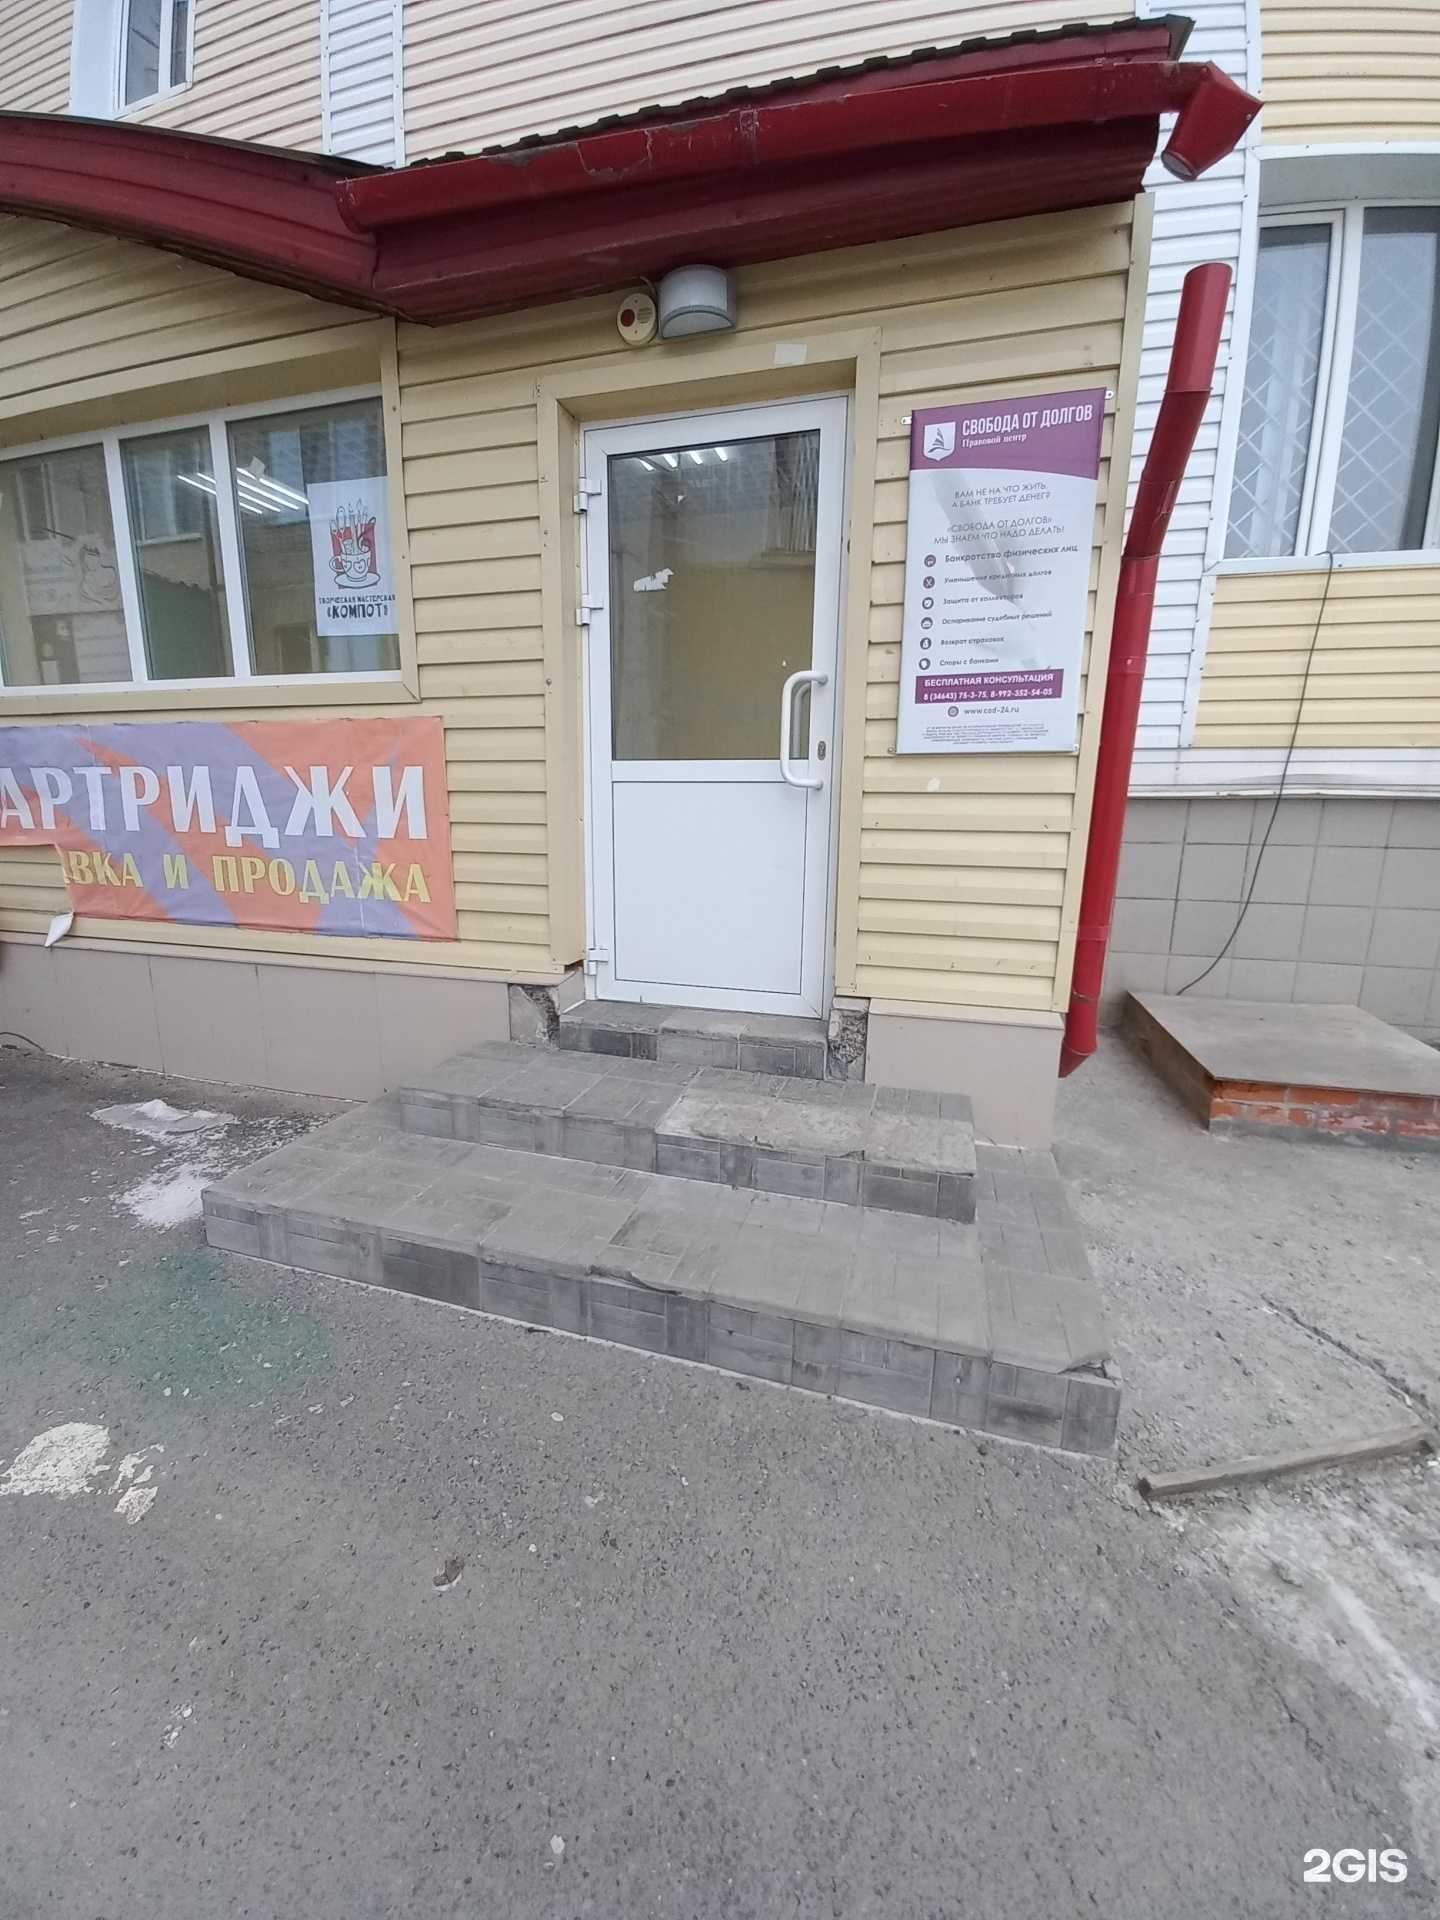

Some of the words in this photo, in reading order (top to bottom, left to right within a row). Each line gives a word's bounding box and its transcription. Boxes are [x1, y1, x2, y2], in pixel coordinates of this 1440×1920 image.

[962, 414, 1020, 436] СВОБОДА
[1022, 411, 1039, 429] ОТ
[1040, 404, 1093, 428] ДОЛГОВ
[962, 435, 1001, 448] Правовой
[1003, 433, 1027, 444] центр
[954, 490, 974, 499] ВАМ
[976, 488, 987, 496] НЕ
[988, 487, 1001, 495] НА
[1003, 484, 1020, 493] ЧТО
[1022, 482, 1046, 492] ЖИТЬ
[960, 499, 981, 507] БАНК
[984, 495, 1017, 505] ТРЕБУЕТ
[997, 519, 1009, 528] ОТ
[1010, 515, 1052, 528] ДОЛГОВ»
[934, 535, 949, 544] МЫ
[951, 534, 980, 543] ЗНАЕМ
[981, 531, 998, 540] ЧТО
[1000, 529, 1026, 538] НАДО
[1028, 526, 1064, 537] ДЕЛАТЬ!
[945, 552, 1002, 563] Банкротство
[1003, 546, 1060, 559] физических
[1060, 545, 1079, 553] лиц
[943, 597, 969, 605] Защита
[939, 659, 962, 667] Споры
[924, 677, 982, 687] БЕСПЛАТНАЯ
[983, 673, 1054, 685] КОНСУЛЬТАЦИЯ
[923, 693, 928, 701] 8
[0, 766, 428, 849] АРТРИДЖИ
[65, 851, 144, 888] ВКА
[163, 853, 190, 890] И
[212, 855, 431, 905] ПРОДАЖА
